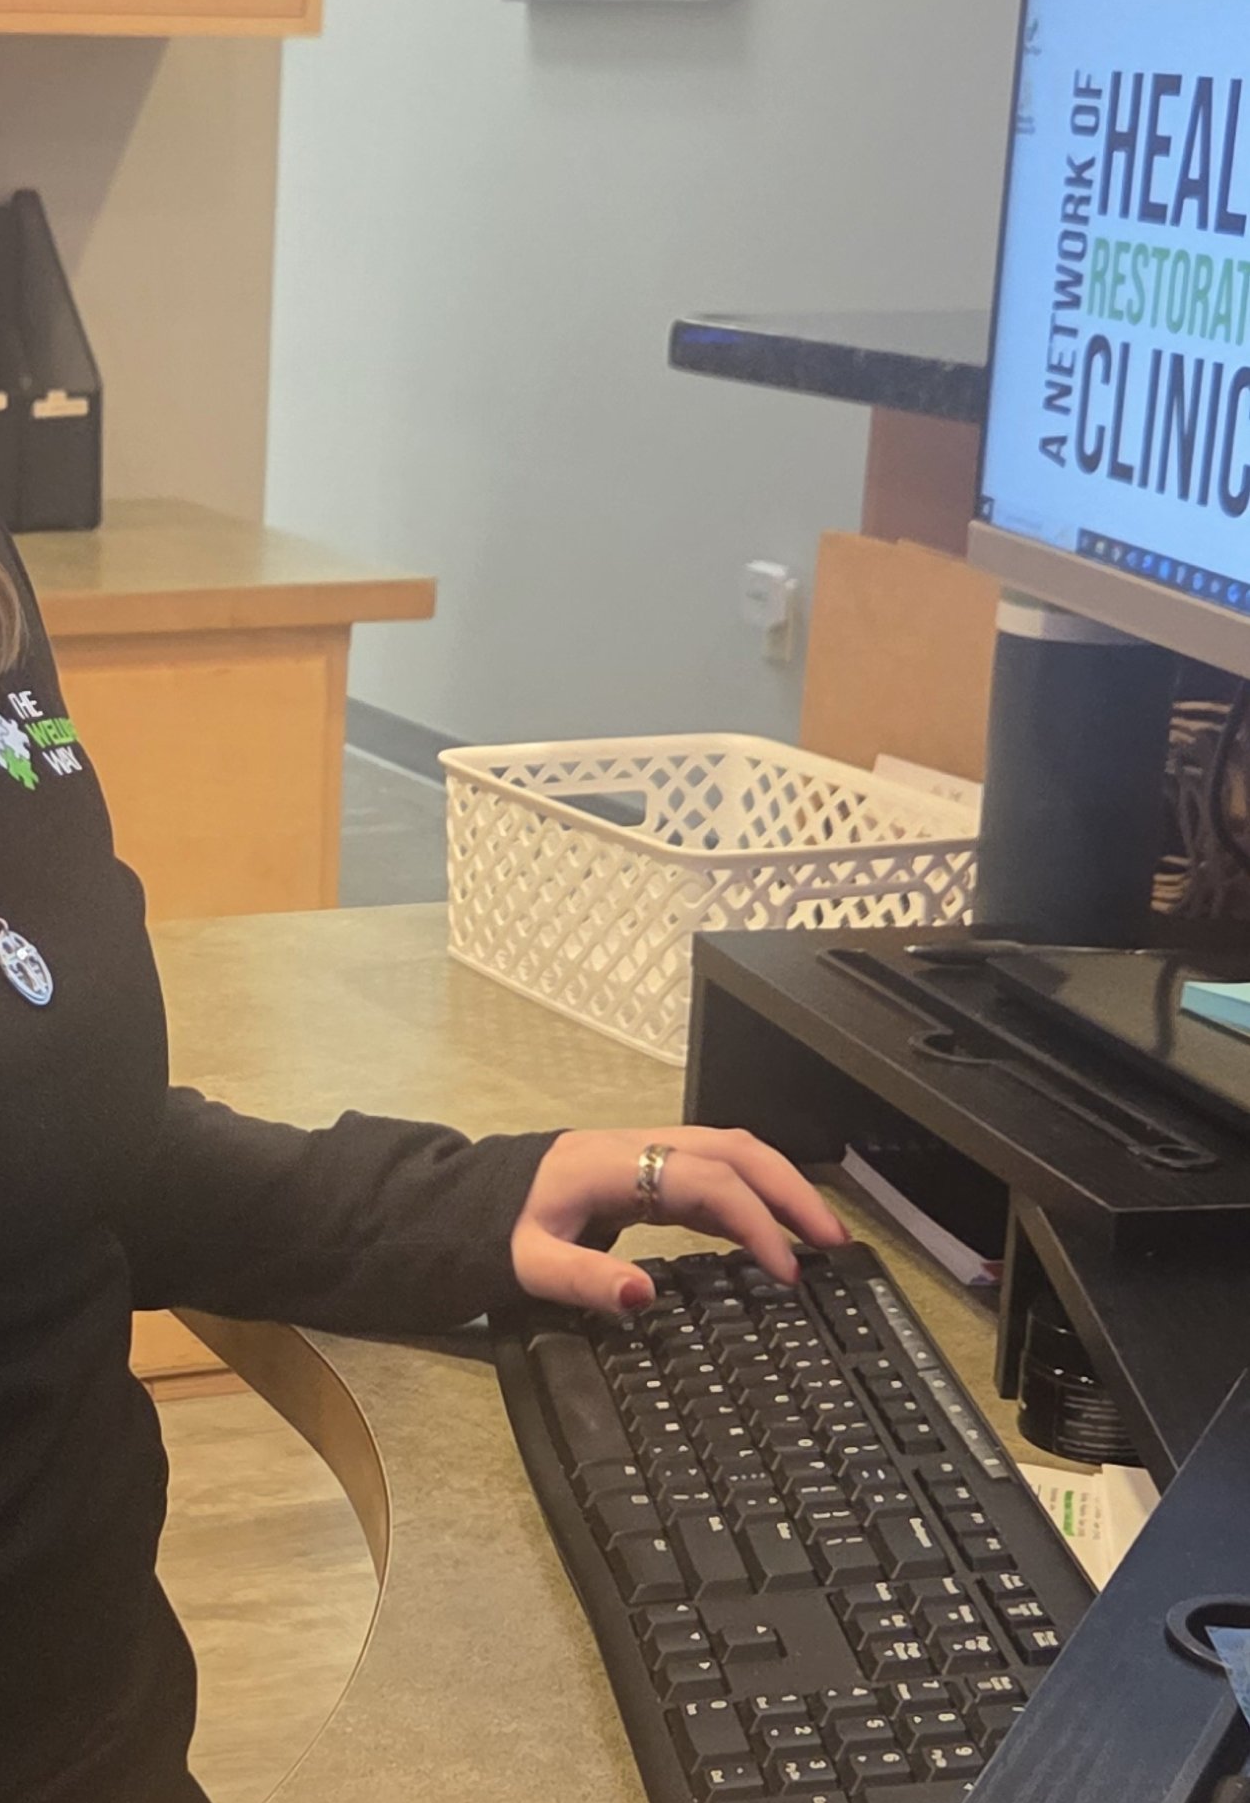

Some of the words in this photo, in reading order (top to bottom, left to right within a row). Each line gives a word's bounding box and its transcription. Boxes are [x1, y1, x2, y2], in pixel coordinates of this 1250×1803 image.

[1070, 69, 1104, 138] OF
[1097, 70, 1248, 238] HEAL
[1042, 153, 1096, 417] NETWORK
[1038, 435, 1068, 468] A
[7, 690, 45, 720] THE
